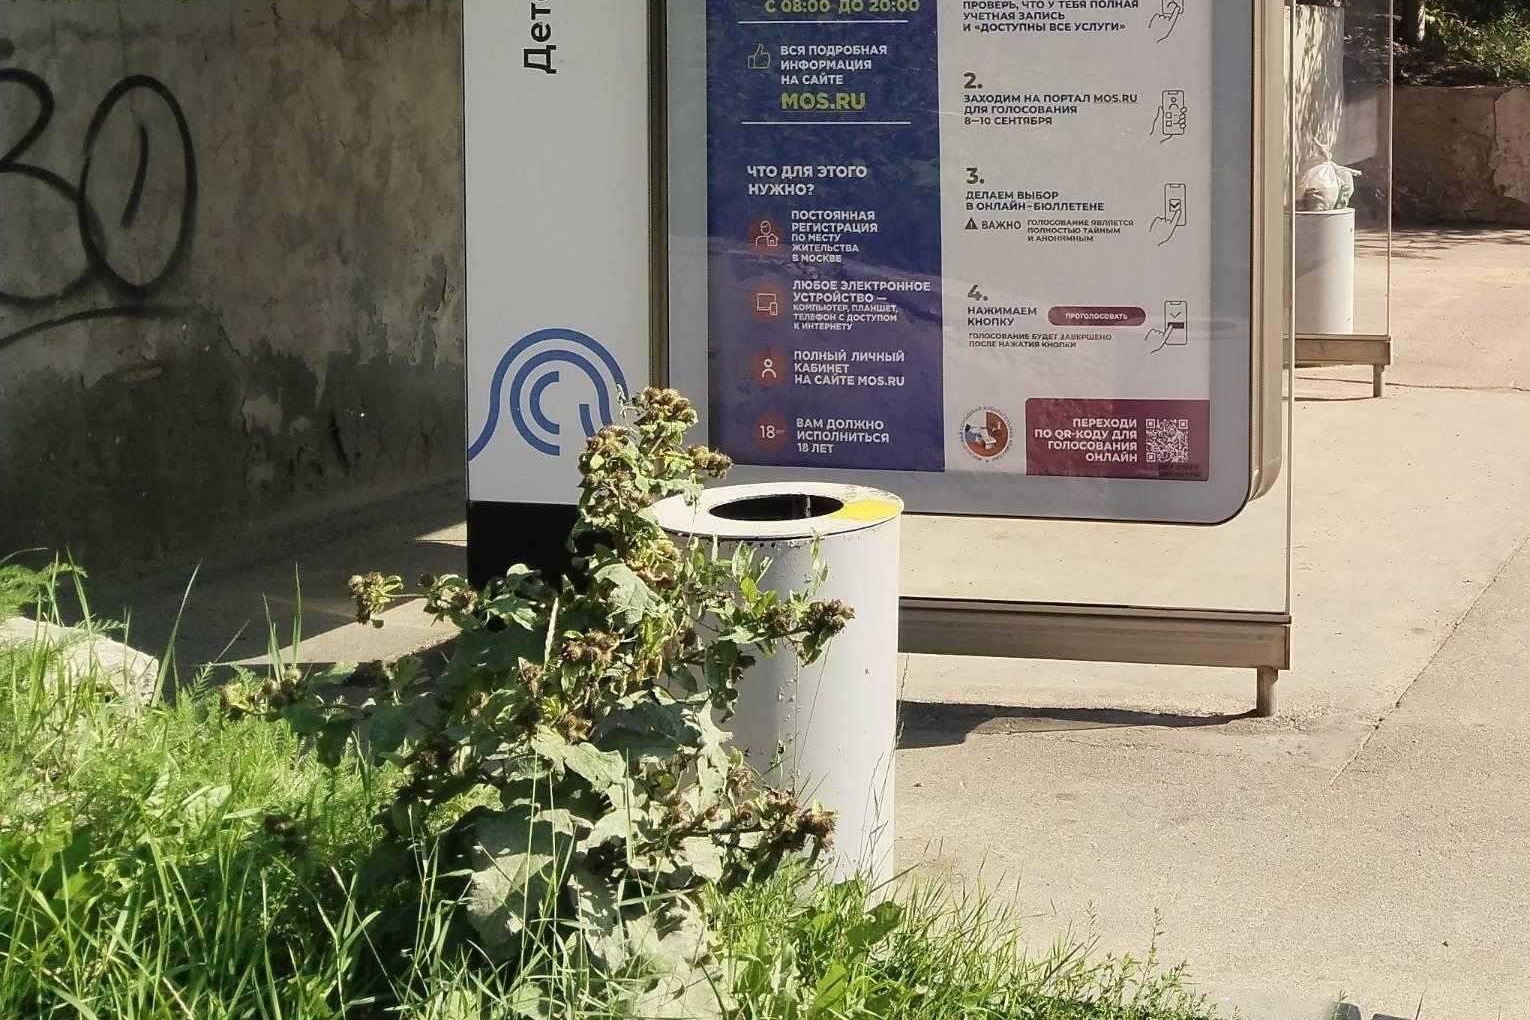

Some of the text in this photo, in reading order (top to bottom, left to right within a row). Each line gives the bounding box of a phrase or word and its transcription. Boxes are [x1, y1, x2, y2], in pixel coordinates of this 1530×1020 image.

[764, 0, 776, 13] С
[963, 0, 1139, 11] ПРОВЕРЬ, ЧТО У ТЕБЯ ПОЛНАЯ
[963, 11, 1066, 21] УЧЕТНАЯ ЗАПИСЬ
[963, 22, 1126, 33] И «ДОСТУПНЫ ВСЕ УСЛУГИ»
[781, 44, 888, 57] ВСЯ ПОДРОБНАЯ
[781, 59, 872, 71] ИНФОРМАЦИЯ
[781, 72, 844, 85] НА САЙТЕ
[963, 72, 983, 89] 2.
[781, 91, 866, 110] MOS.RU
[963, 94, 1138, 104] ЗАХОДИМ НА ПОРТАЛ MOS.RU
[964, 105, 1078, 116] ДЛЯ ГОЛОСОВАНИЯ
[994, 116, 1053, 126] СЕНТЯБРЯ
[747, 165, 868, 180] ЧТО ДЛЯ ЭТОГО
[965, 167, 985, 184] 3.
[748, 183, 815, 196] НУЖНО?
[965, 190, 1060, 201] ДЕЛАЕМ ВЫБОР
[966, 200, 1105, 211] В ОНЛАЙН-БЮЛЛЕТЕНЕ
[791, 210, 875, 221] ПОСТОЯННАЯ
[791, 222, 878, 234] РЕГИСТРАЦИЯ
[981, 220, 1022, 230] ВАЖНО
[791, 234, 841, 243] ПО МЕСТУ
[792, 243, 859, 253] ЖИТЕЛЬСТВА
[792, 254, 842, 263] В МОСКВЕ
[793, 280, 932, 292] ЛЮБОЕ ЭЛЕКТРОННОЕ
[793, 291, 874, 303] УСТРОЙСТВО
[967, 306, 1037, 316] НАЖИМАЕМ
[793, 313, 836, 322] ТЕЛЕФОН
[847, 313, 898, 323] ДОСТУПОМ
[967, 317, 1015, 326] КНОПКУ
[802, 322, 853, 331] ИНТЕРНЕТУ
[794, 348, 905, 362] ПОЛНЫЙ ЛИЧНЫЙ
[794, 363, 850, 374] КАБИНЕТ
[794, 373, 905, 386] НА САЙТЕ MOS.RU
[796, 418, 884, 431] ВАМ ДОЛЖНО
[1072, 418, 1138, 429] ПЕРЕХОДИ
[759, 425, 776, 439] 18
[796, 430, 890, 443] ИСПОЛНИТЬСЯ
[1034, 430, 1137, 441] ПО QR-КОДУ ДЛЯ
[797, 443, 834, 454] 18 ЛЕТ
[1047, 440, 1137, 451] ГОЛОСОВАНИЯ
[1085, 451, 1138, 462] ОНЛАЙН
